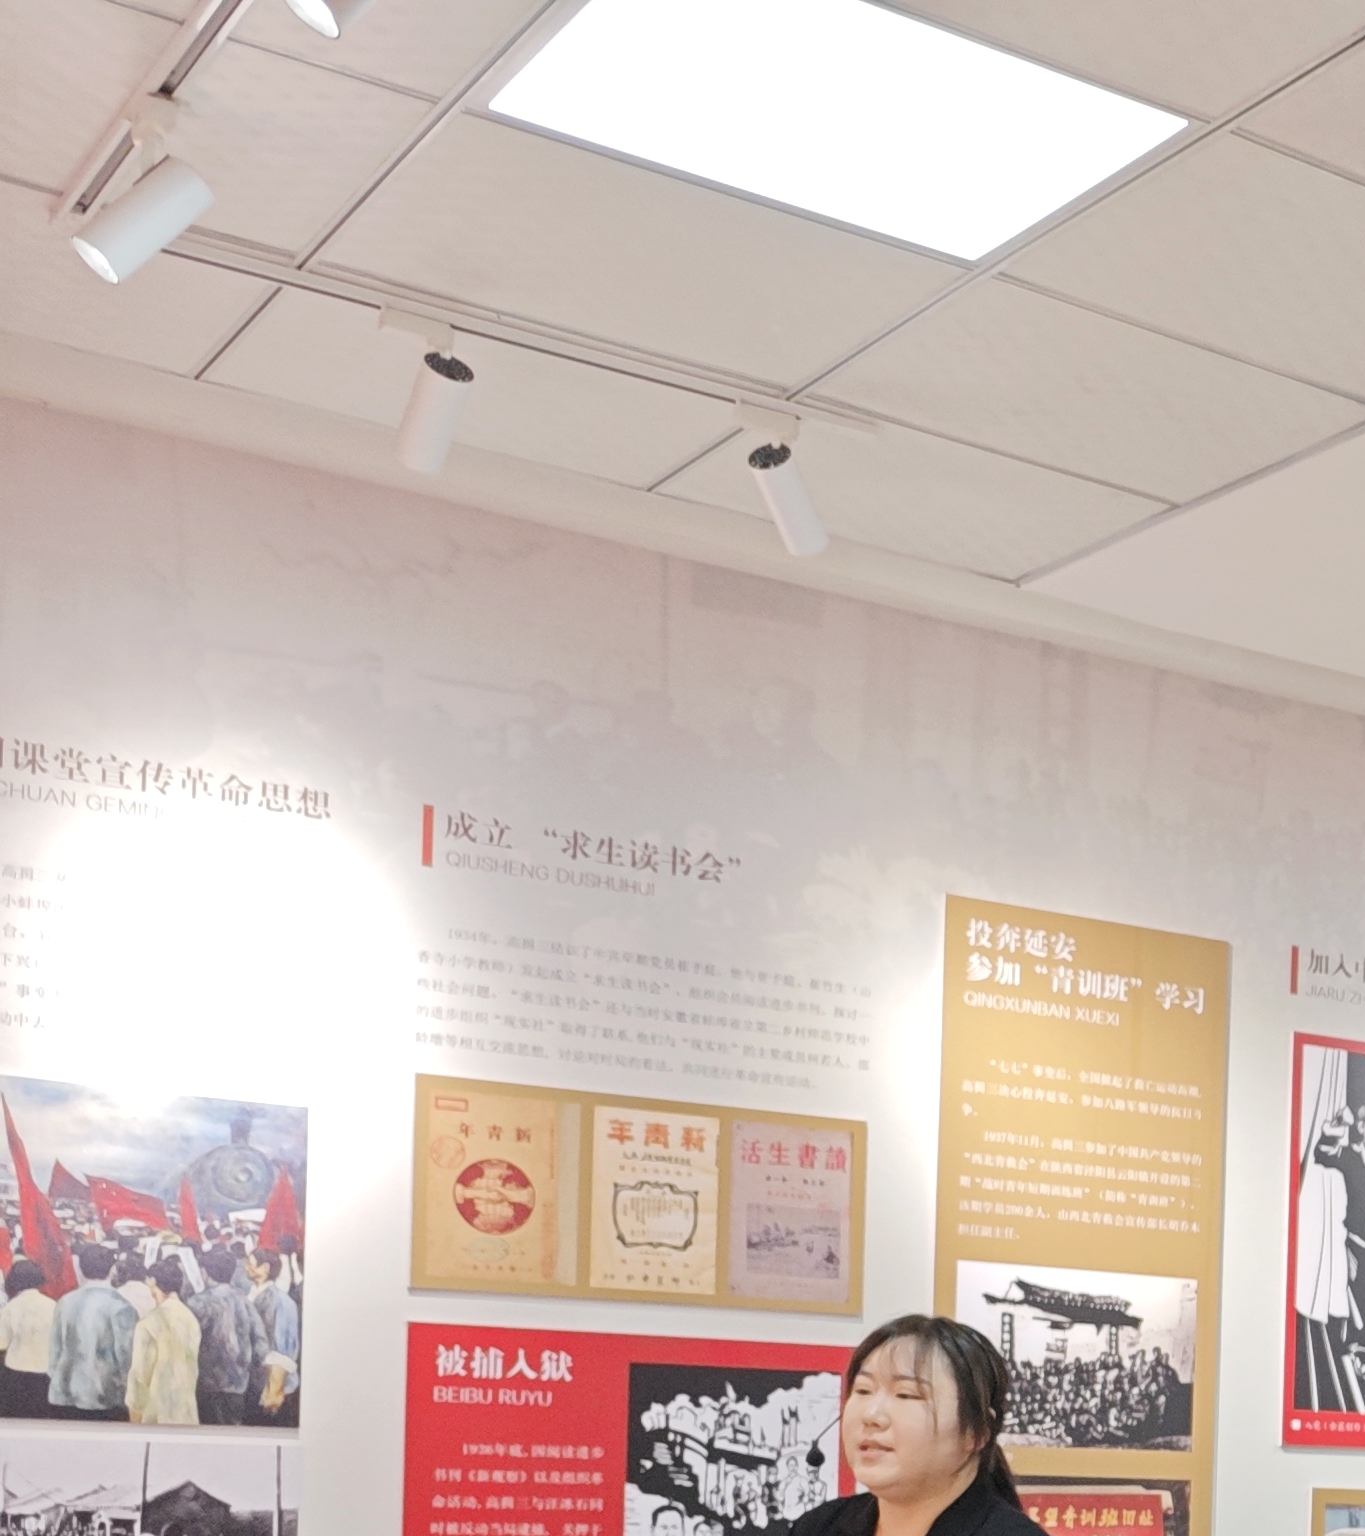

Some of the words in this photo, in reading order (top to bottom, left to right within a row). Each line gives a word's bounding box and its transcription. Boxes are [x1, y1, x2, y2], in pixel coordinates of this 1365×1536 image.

[0, 737, 331, 819] 课堂宣传革命思想
[446, 850, 550, 880] QIUSHENG
[556, 867, 655, 897] DUSHUHUI
[966, 917, 1077, 962] 投奔延安
[963, 990, 1070, 1021] QINGXUNBAN
[1075, 1007, 1120, 1026] XUEXI
[1306, 985, 1345, 1002] JIARU
[435, 1343, 573, 1382] 被捕入狱
[433, 1385, 493, 1404] BEIBU
[498, 1386, 552, 1406] RUYU
